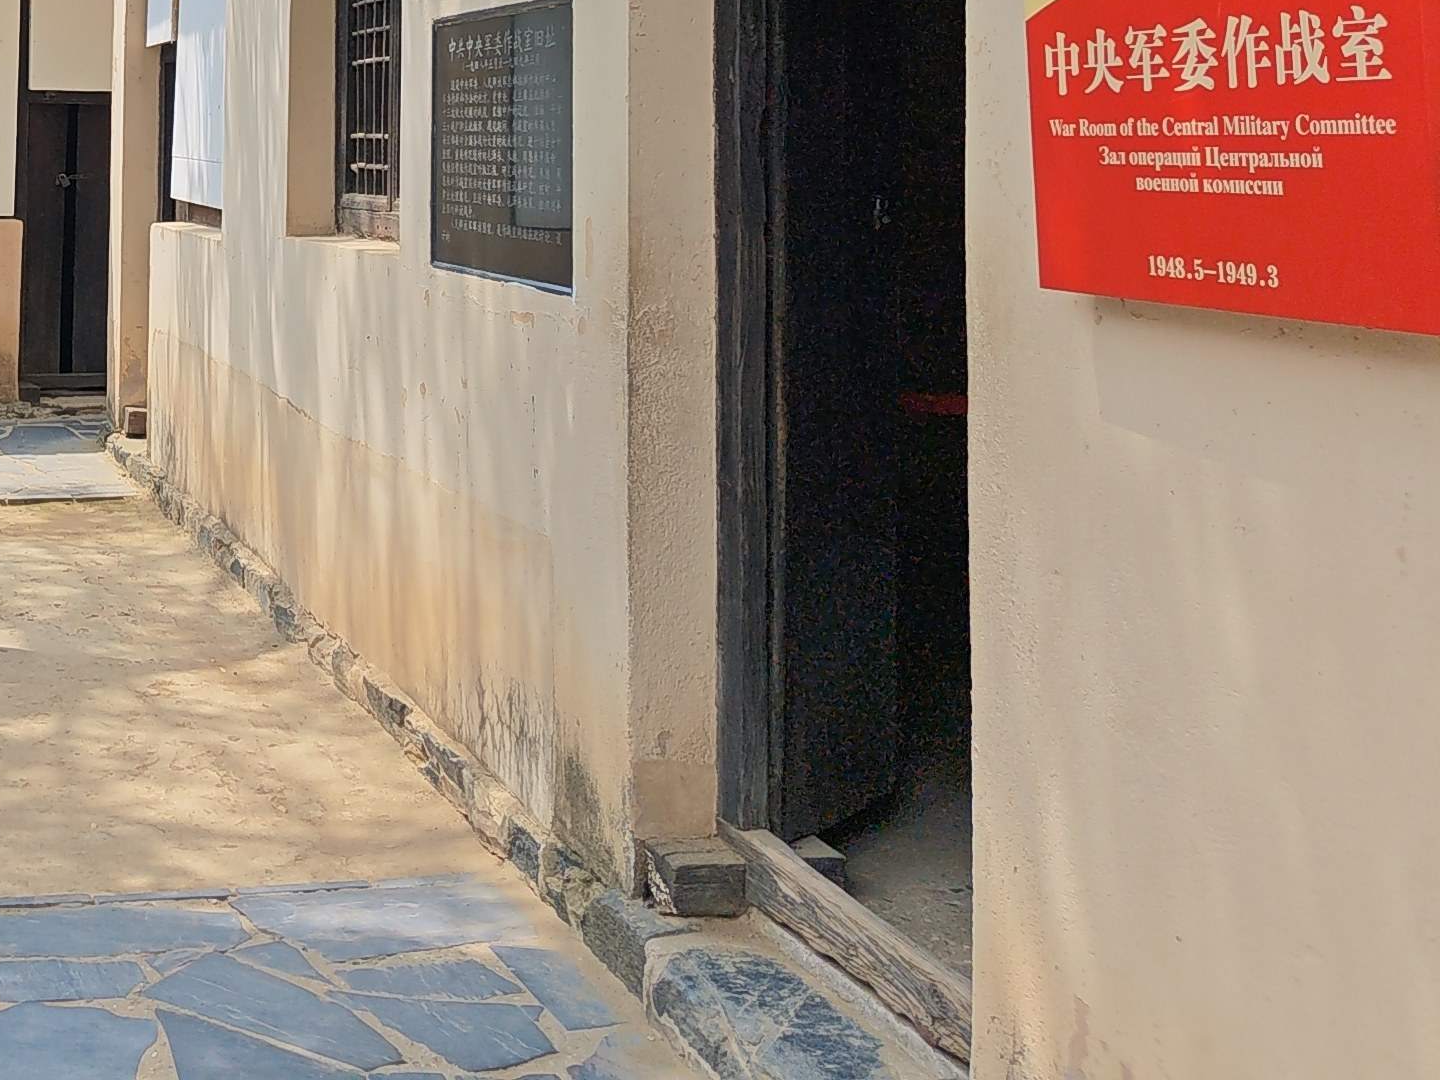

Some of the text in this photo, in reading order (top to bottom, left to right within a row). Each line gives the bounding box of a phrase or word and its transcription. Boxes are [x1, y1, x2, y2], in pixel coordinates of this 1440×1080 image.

[1044, 5, 1393, 96] 中央军委作战室
[1048, 113, 1397, 141] War Room of the Central Military Committee
[1098, 145, 1324, 174] Зал операций Центральной
[1135, 172, 1284, 196] военной комиссии
